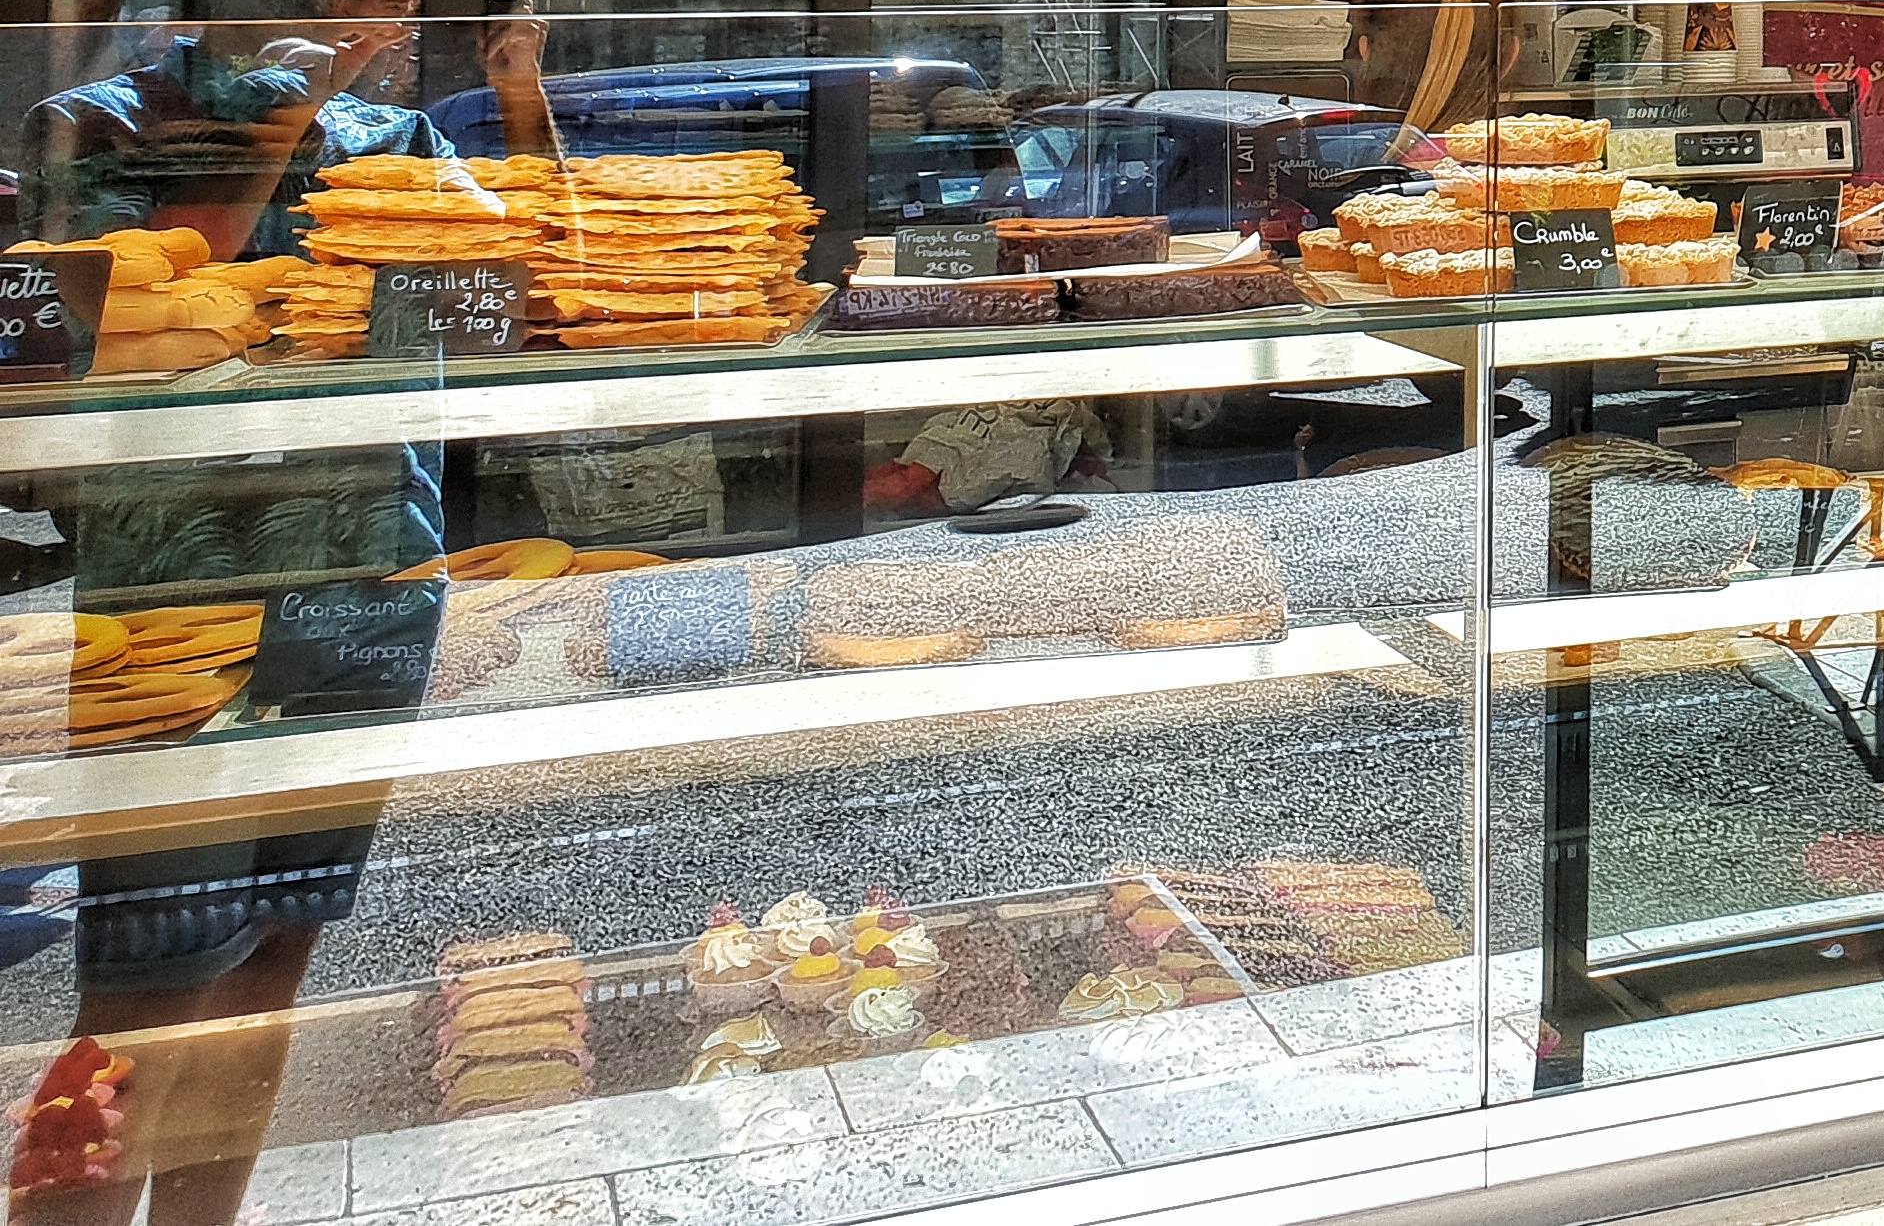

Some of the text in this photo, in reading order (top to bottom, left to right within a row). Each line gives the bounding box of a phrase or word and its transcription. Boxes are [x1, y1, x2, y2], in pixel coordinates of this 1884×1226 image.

[1237, 132, 1254, 173] LAIT
[1752, 202, 1830, 223] Florentin
[390, 267, 513, 291] Oreillette
[280, 589, 411, 622] Croissant
[337, 642, 424, 666] Pignons
